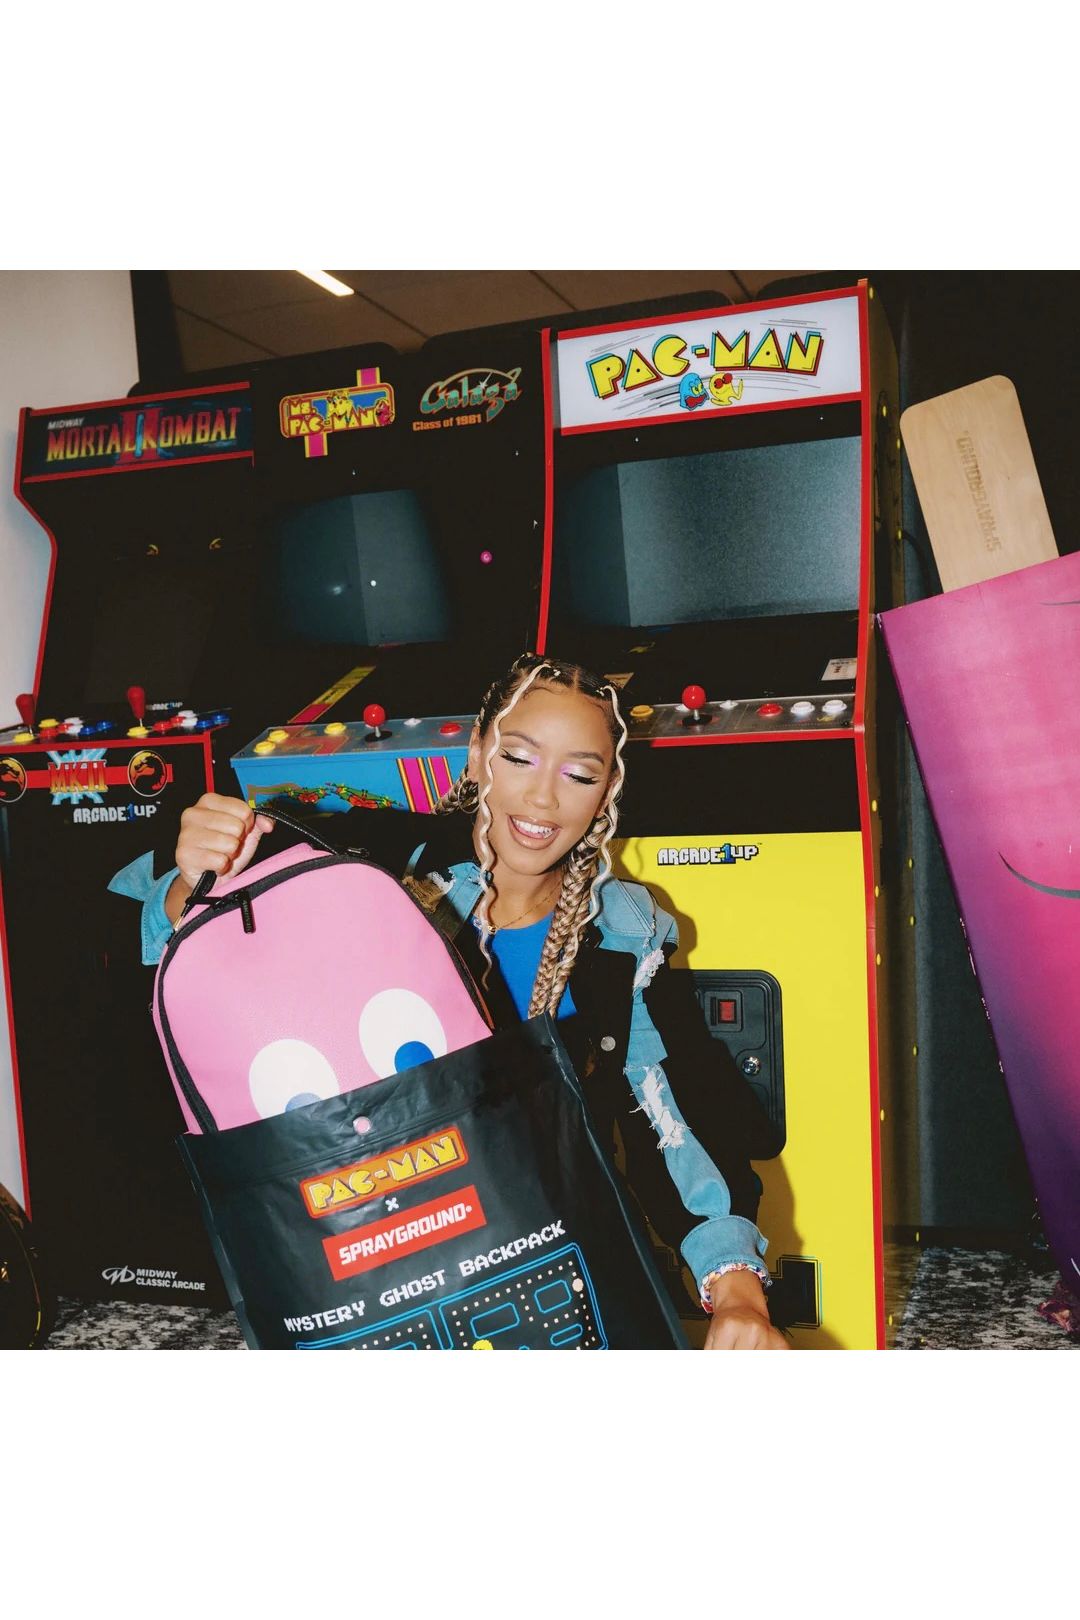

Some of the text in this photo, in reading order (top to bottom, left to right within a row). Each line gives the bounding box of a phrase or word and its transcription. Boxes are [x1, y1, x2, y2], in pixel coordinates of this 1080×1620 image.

[585, 328, 824, 400] PAC-MAN
[420, 367, 522, 422] Galaga
[46, 423, 137, 462] MORTAL
[141, 408, 241, 453] KOMBAT
[47, 417, 84, 430] MIDWAY
[289, 407, 376, 437] PAC-MAN
[412, 413, 482, 431] Class of 1981
[309, 1135, 459, 1209] PAC-MAN
[135, 1277, 206, 1291] CLASSIC ARCADE
[136, 1268, 177, 1279] MIDWAY
[284, 1220, 566, 1333] MYSTERY GHOST BACKPACK
